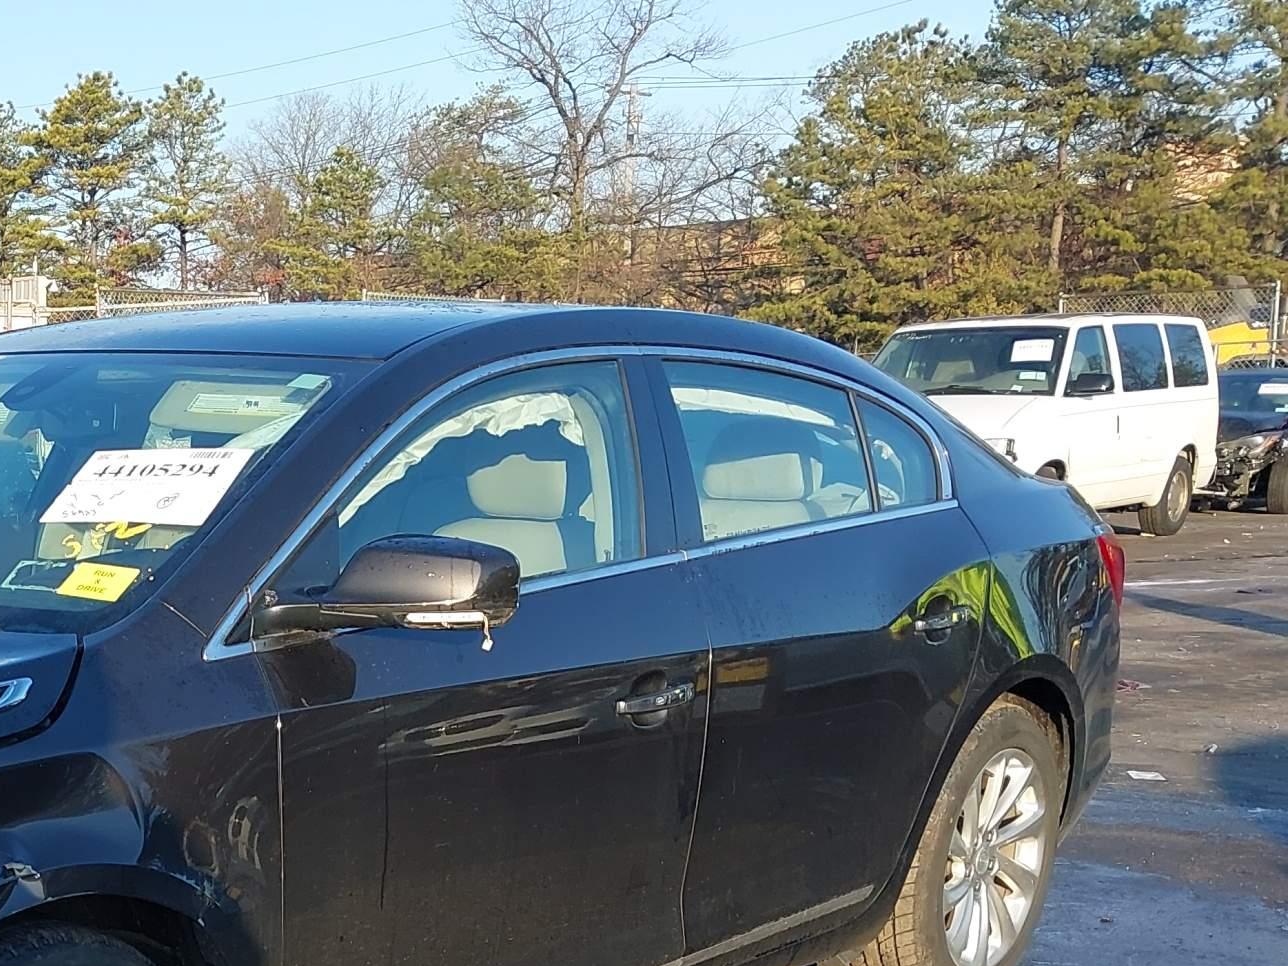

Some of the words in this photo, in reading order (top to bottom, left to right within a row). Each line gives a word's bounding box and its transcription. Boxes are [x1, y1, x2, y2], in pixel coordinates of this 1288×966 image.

[93, 463, 220, 477] 44105294
[93, 569, 116, 578] RUN
[75, 584, 107, 594] DRIVE
